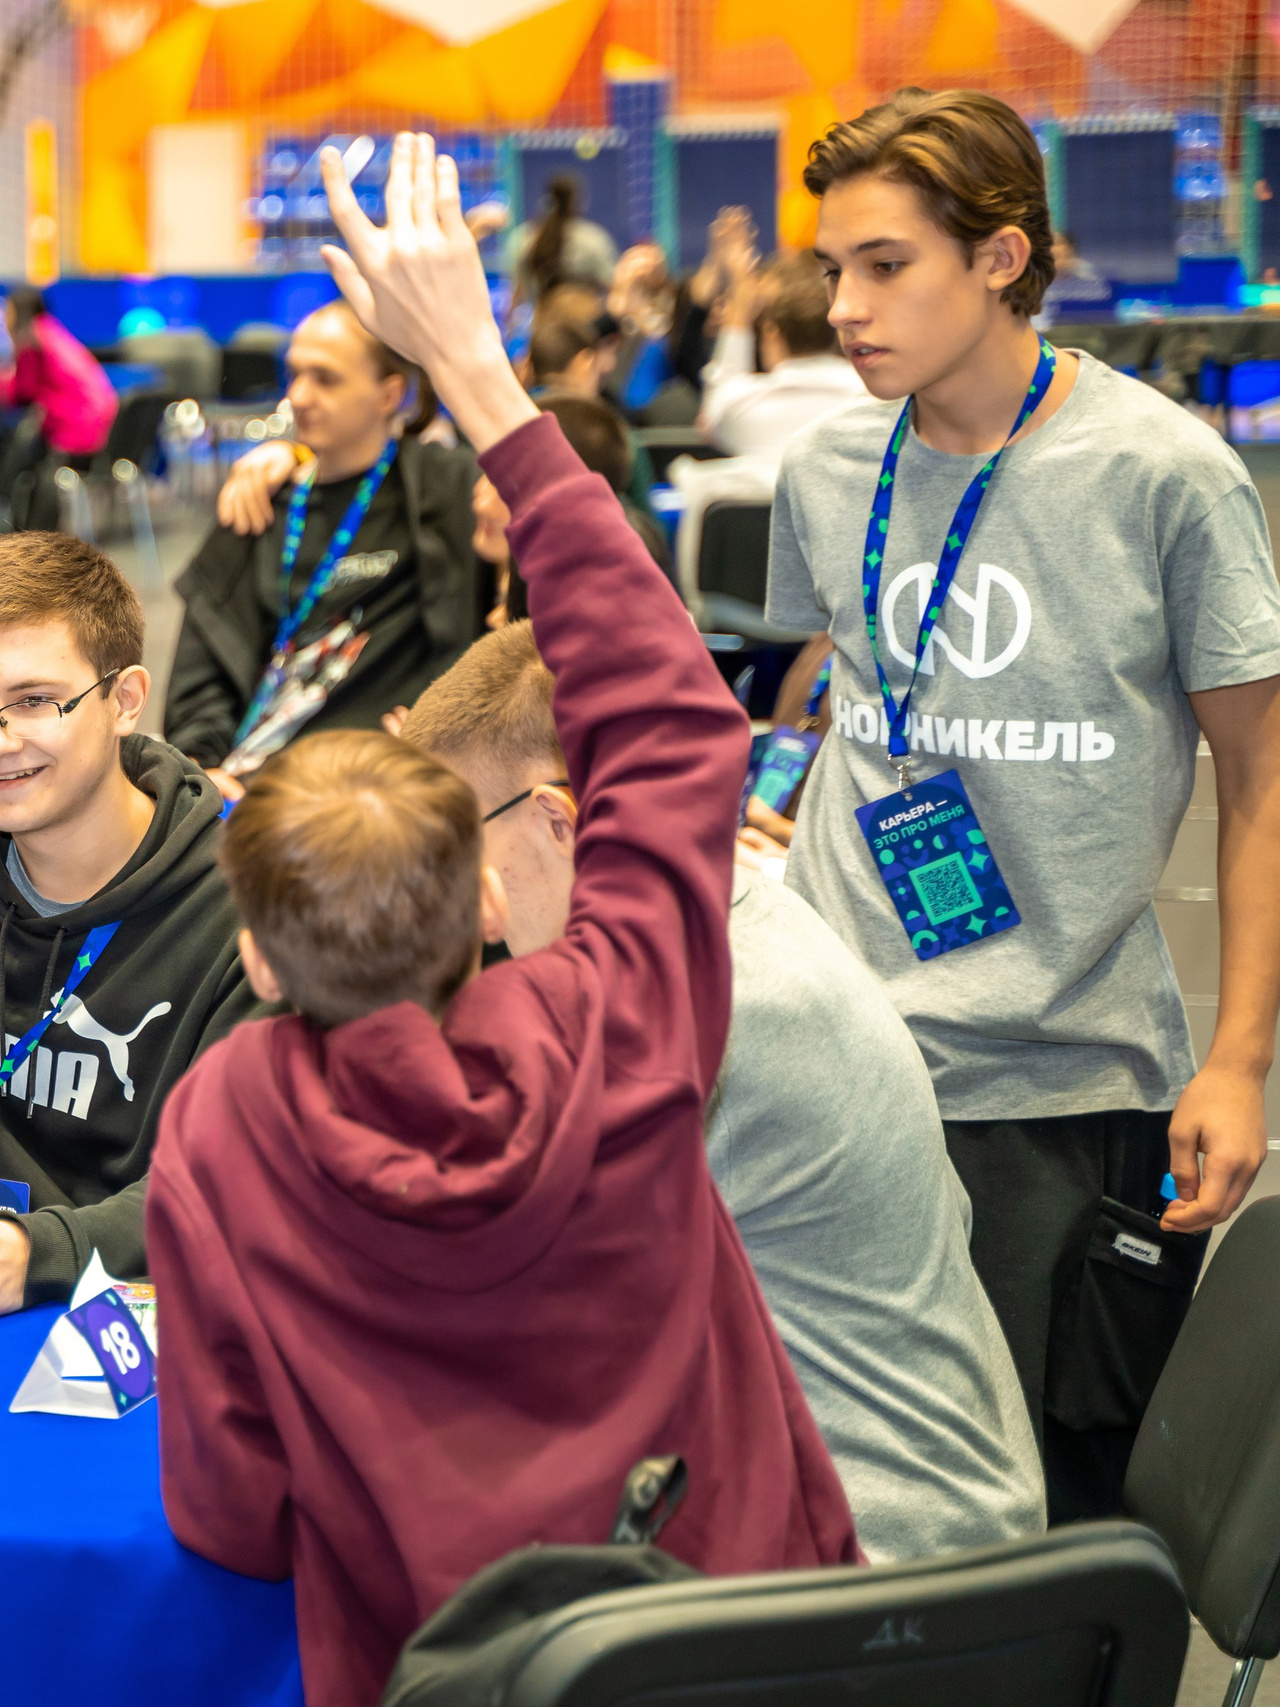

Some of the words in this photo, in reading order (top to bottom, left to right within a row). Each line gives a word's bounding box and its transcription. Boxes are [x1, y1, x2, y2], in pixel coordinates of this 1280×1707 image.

[873, 831, 900, 849] ЭТО
[900, 820, 928, 838] ПРО
[928, 804, 965, 827] МЕНЯ
[879, 801, 936, 832] КАРЬЕРА
[100, 1321, 140, 1375] 18
